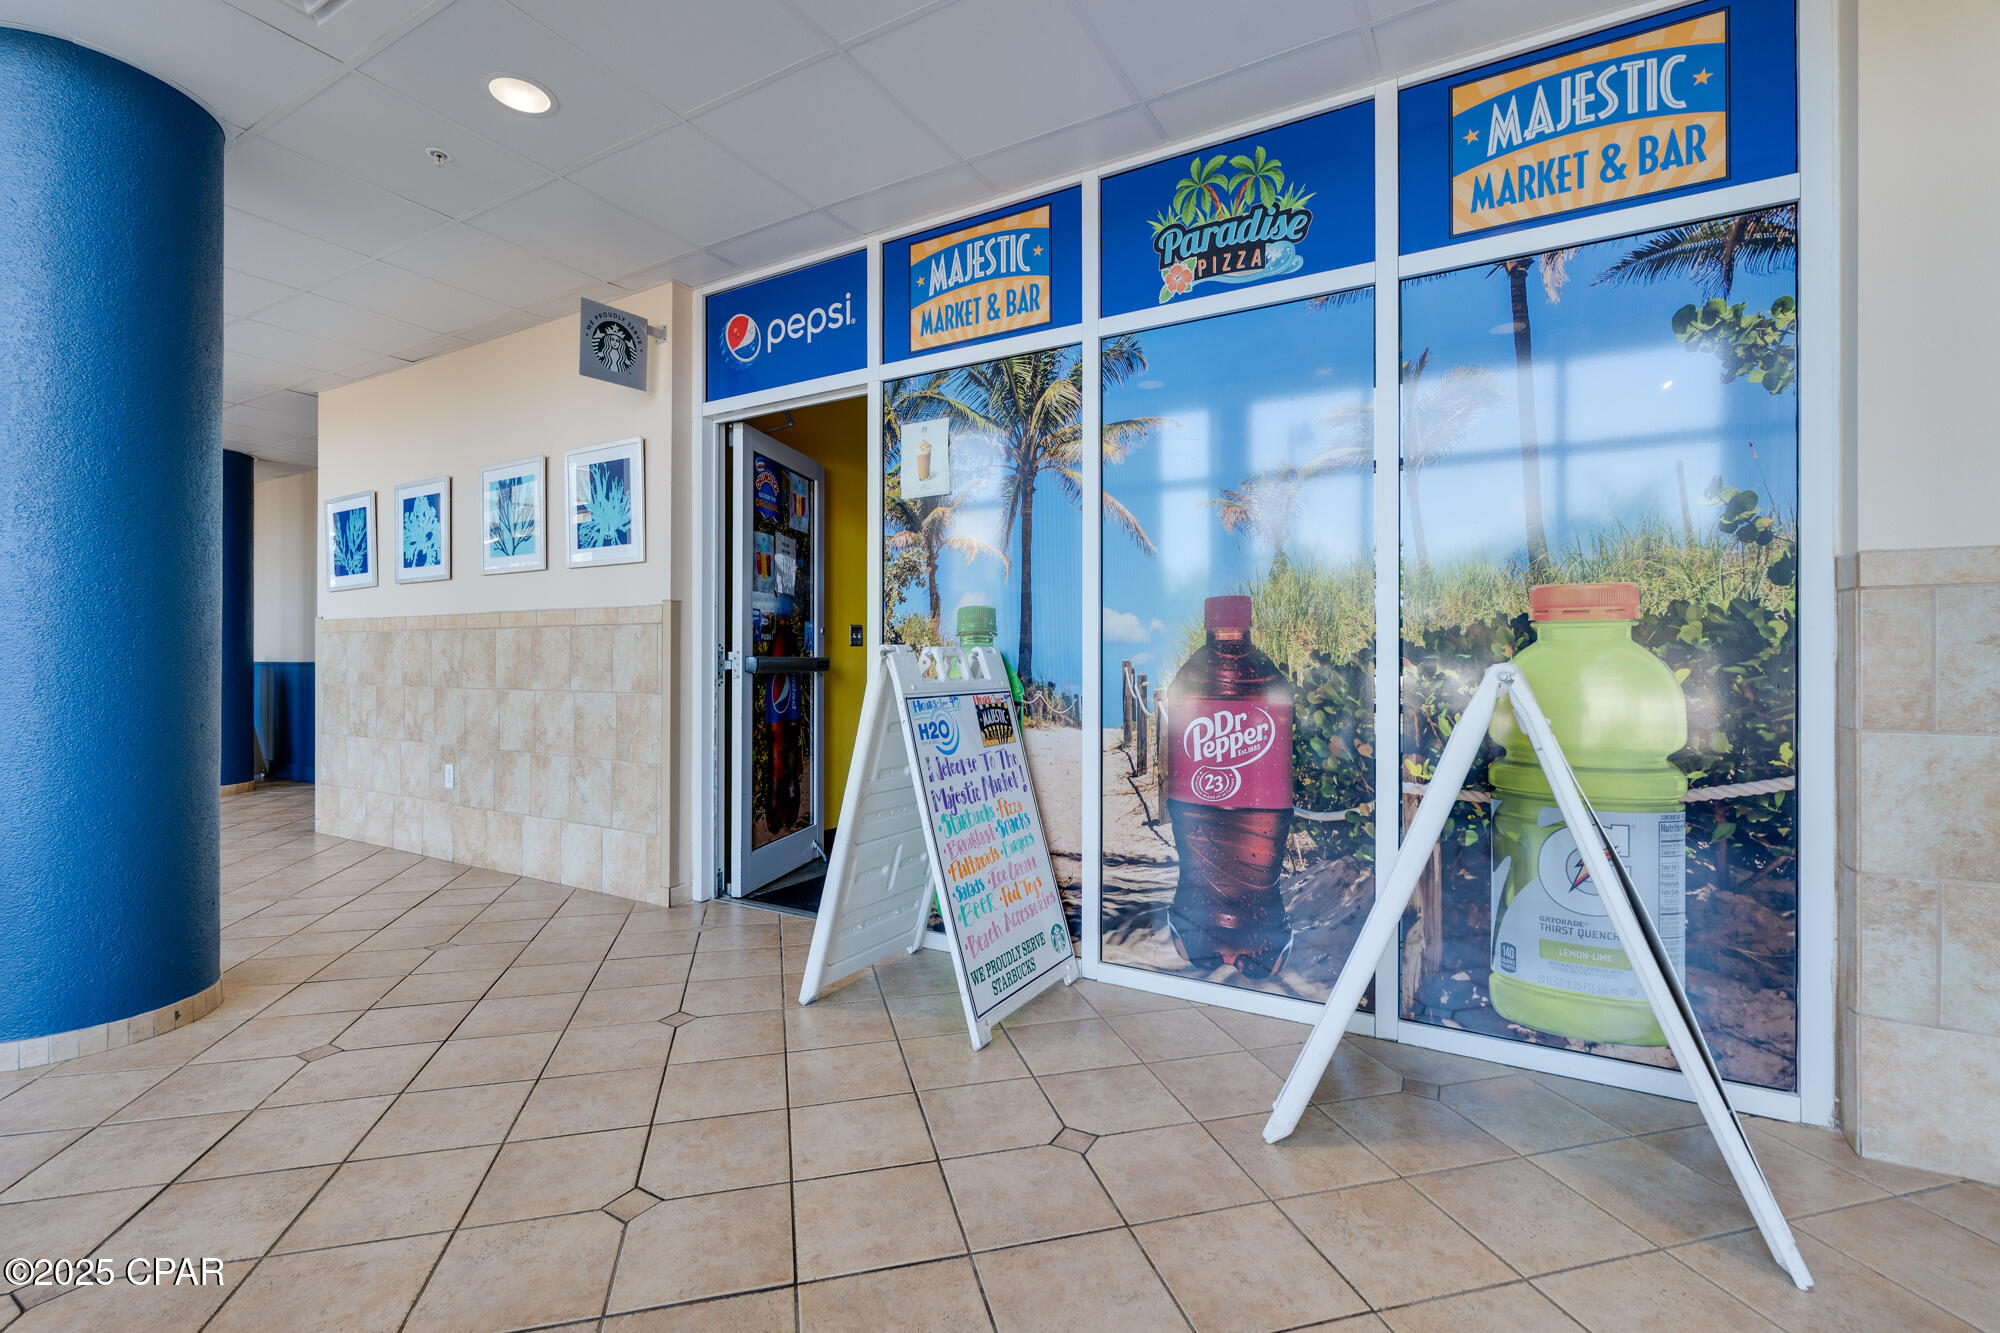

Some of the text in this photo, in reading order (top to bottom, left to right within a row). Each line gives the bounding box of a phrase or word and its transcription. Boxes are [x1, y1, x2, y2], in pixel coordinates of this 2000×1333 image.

[1486, 54, 1688, 158] MAJESTIC
[1470, 123, 1708, 214] MARKET & BAR
[1157, 206, 1308, 265] Paradise
[928, 233, 1031, 298] MAJESTIC
[1197, 248, 1263, 277] PIZZA
[586, 319, 595, 330] WE
[595, 311, 626, 322] PROUDLY
[767, 291, 851, 354] pepsi
[920, 283, 1041, 337] MARKET & BAR
[917, 719, 950, 741] H2O
[1213, 710, 1248, 738] Dr
[1189, 716, 1269, 763] Pepper
[978, 750, 996, 772] To
[1204, 774, 1224, 793] 23
[953, 878, 985, 903] Salads
[1539, 915, 1585, 928] GATORADE
[1540, 922, 1621, 941] THIRST QUENCH
[970, 932, 1046, 986] WE PROUDLY SERVE
[1502, 944, 1515, 960] 140
[992, 957, 1037, 996] STARBUCKS
